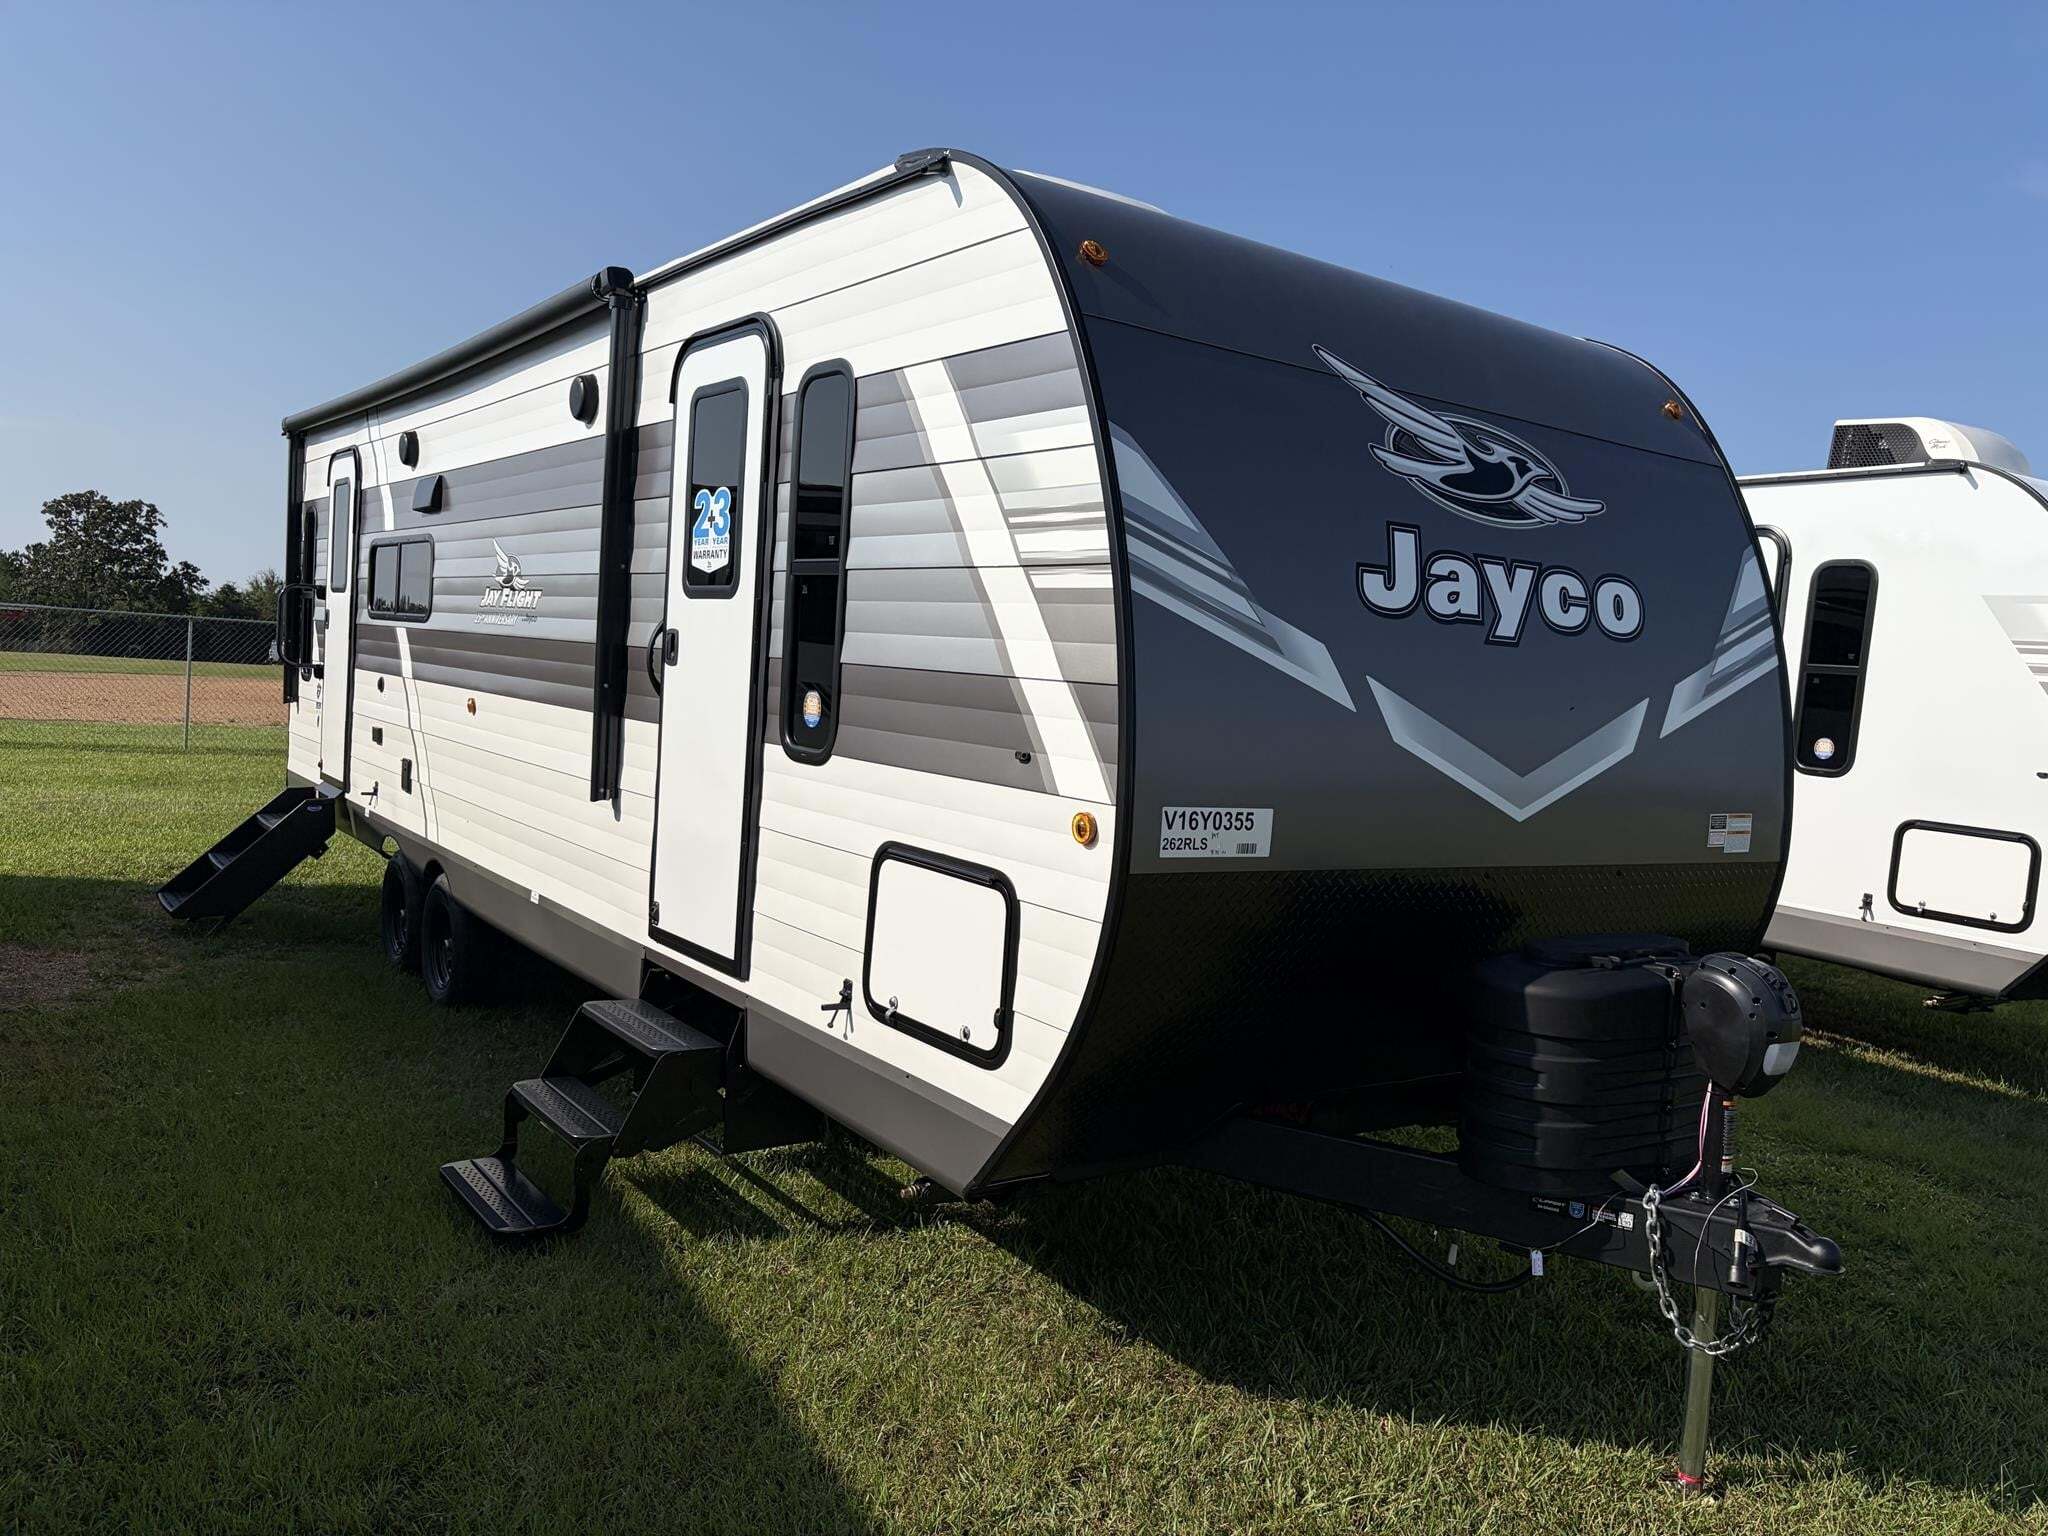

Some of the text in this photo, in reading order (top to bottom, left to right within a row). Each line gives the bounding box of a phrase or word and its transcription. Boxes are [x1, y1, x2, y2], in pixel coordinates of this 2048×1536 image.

[694, 536, 729, 546] YEAR YEAR
[693, 549, 728, 560] WARRANTY
[1356, 521, 1645, 647] Jayco
[480, 587, 542, 609] JAY FLIGHT
[1164, 810, 1254, 831] V16Y0355
[1162, 837, 1208, 851] 262RLS
